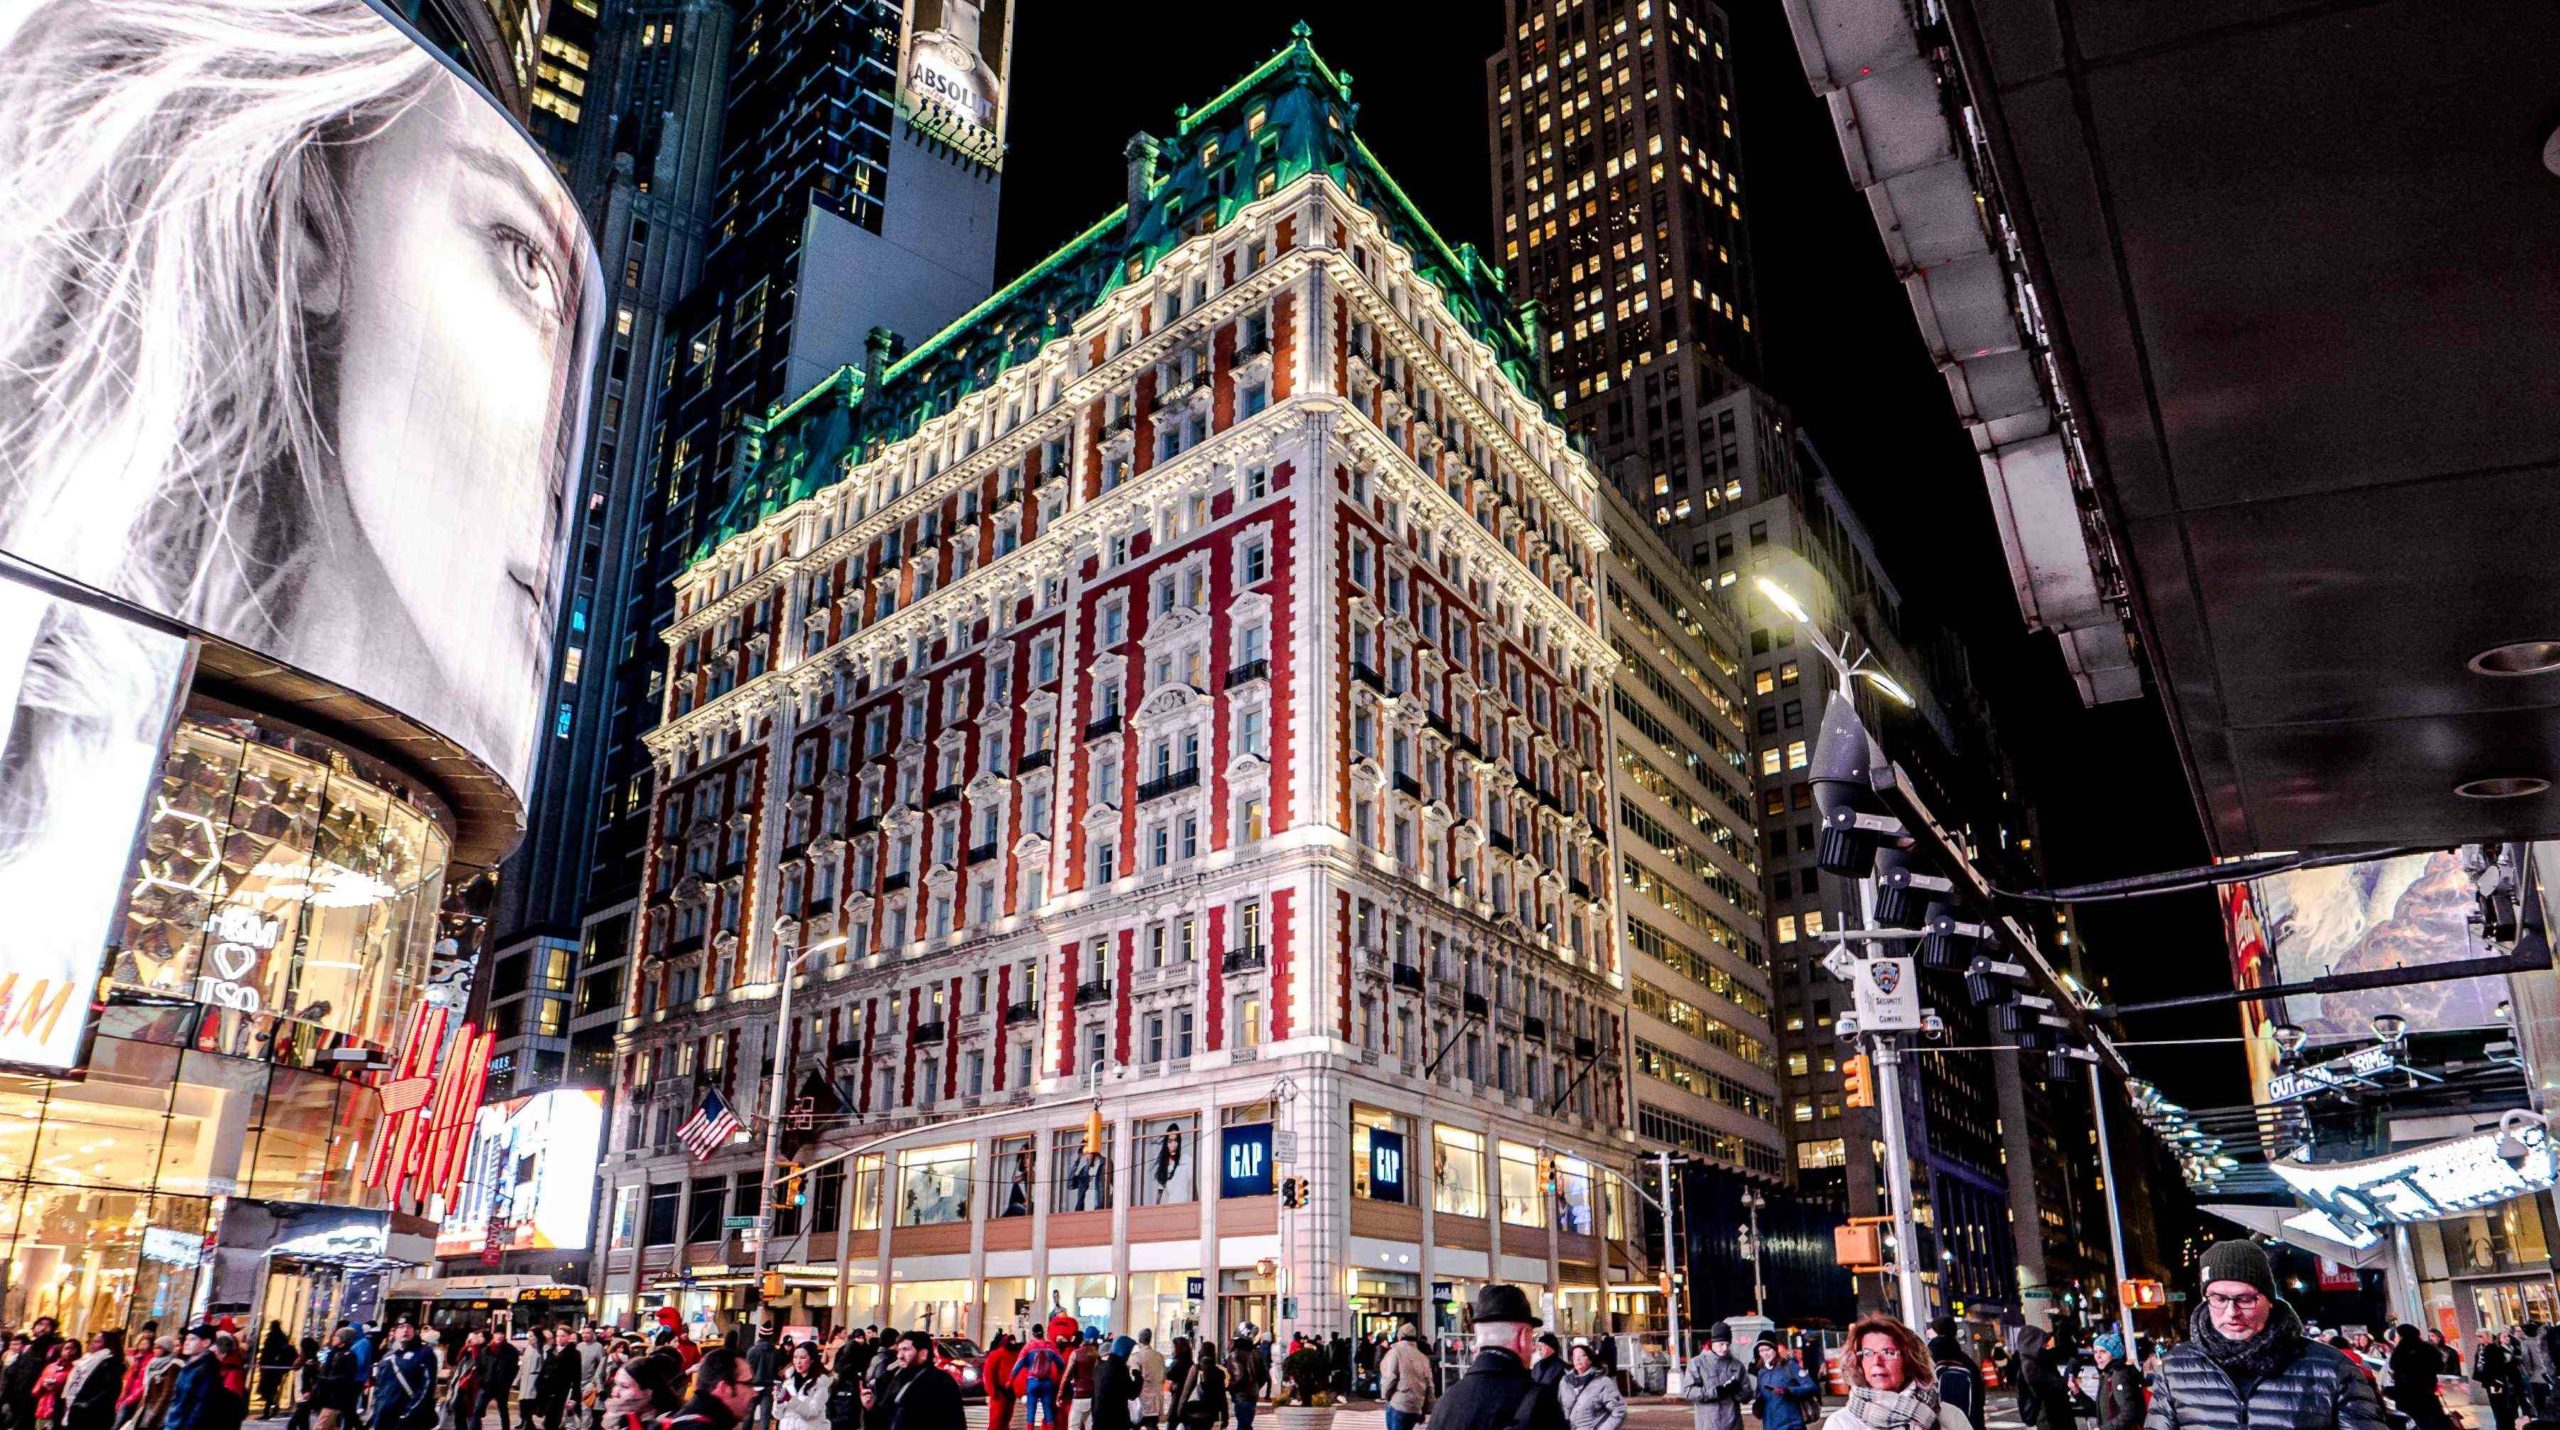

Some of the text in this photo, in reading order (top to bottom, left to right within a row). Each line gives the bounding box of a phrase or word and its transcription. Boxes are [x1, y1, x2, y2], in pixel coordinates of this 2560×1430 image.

[914, 63, 993, 118] ABSOLUT
[1231, 1142, 1262, 1178] GAP
[1376, 1147, 1400, 1183] GAP
[2308, 1165, 2438, 1243] LOFT
[1190, 1282, 1202, 1294] GAP
